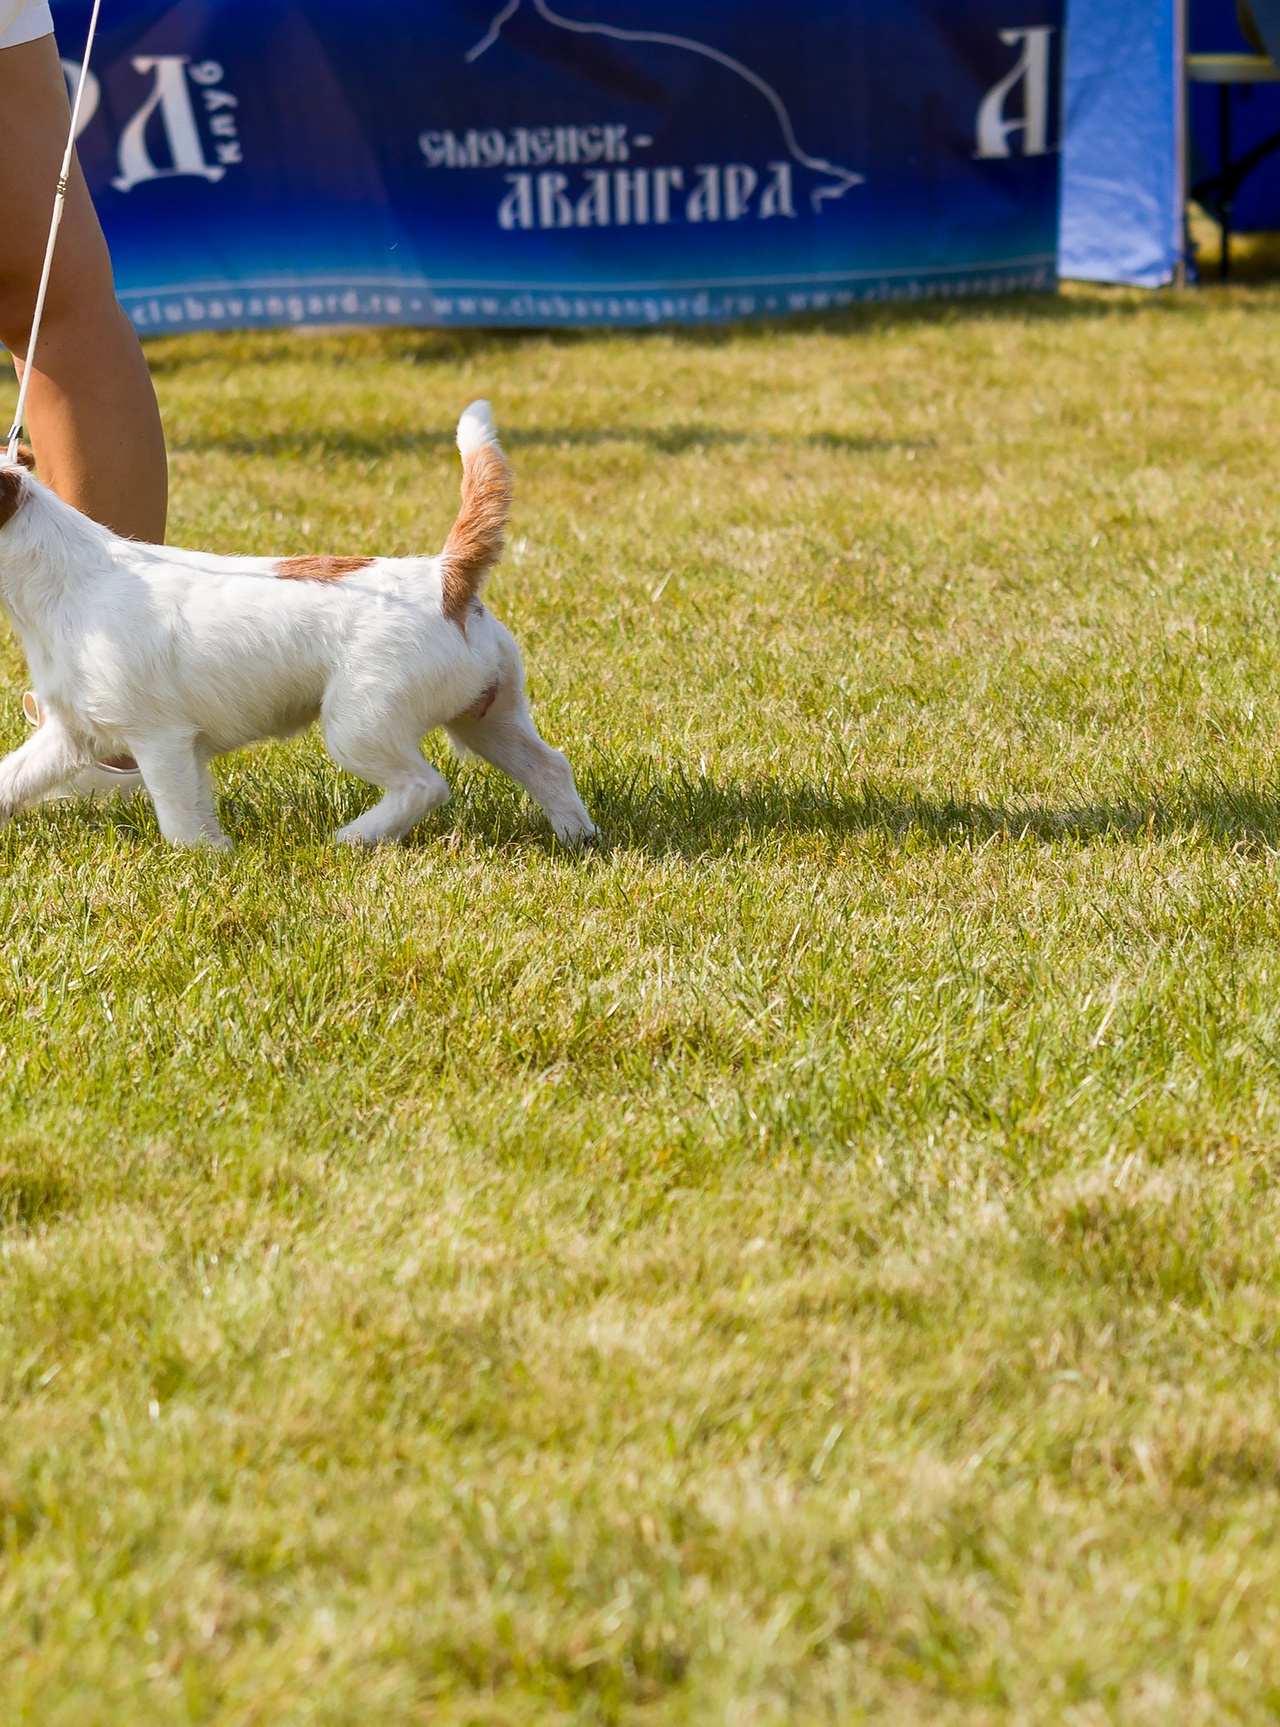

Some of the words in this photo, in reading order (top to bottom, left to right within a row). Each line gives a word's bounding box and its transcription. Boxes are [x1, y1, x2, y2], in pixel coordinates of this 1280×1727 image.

[497, 162, 797, 230] АВАНГАРД
[132, 288, 402, 326] clubavangard.ru
[431, 291, 755, 322] www.clubavangard.ru
